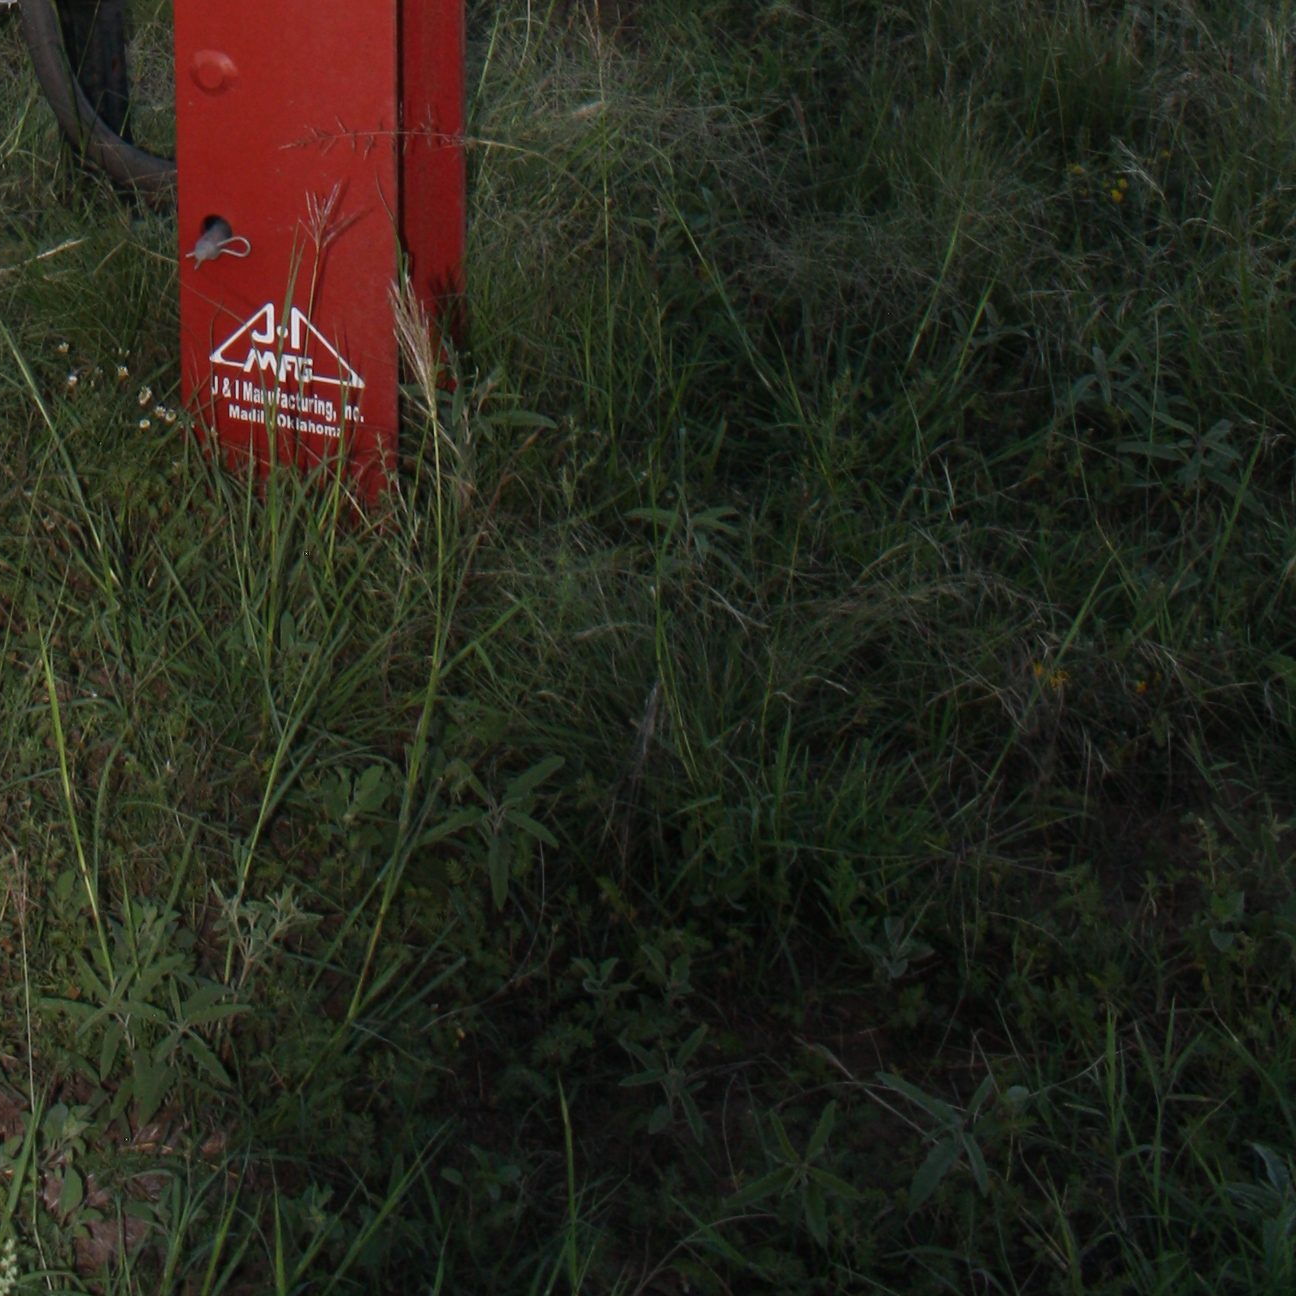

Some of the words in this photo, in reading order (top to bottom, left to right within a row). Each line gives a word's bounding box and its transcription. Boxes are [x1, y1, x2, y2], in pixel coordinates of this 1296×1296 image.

[211, 375, 219, 396] J
[222, 377, 232, 398] &
[341, 404, 365, 423] nc.
